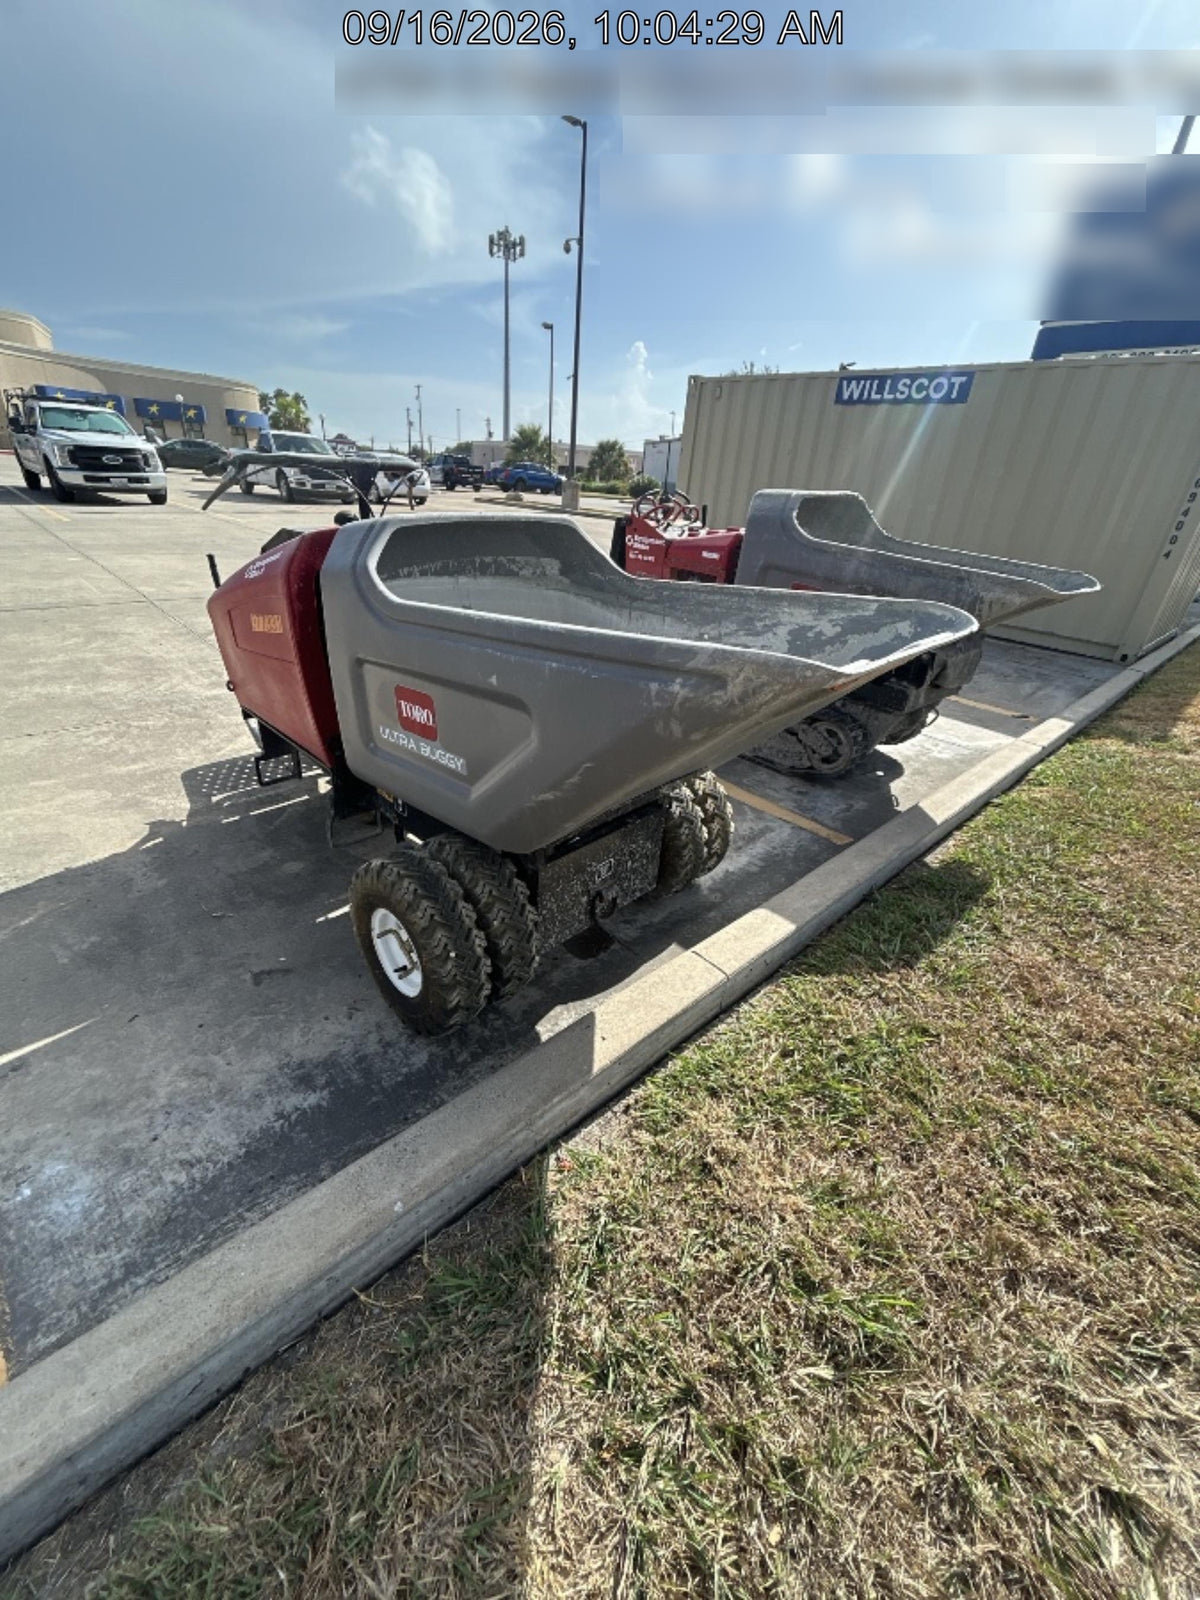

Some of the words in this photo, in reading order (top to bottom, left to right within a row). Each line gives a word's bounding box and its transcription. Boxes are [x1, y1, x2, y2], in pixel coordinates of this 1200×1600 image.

[842, 376, 968, 400] WILLSCOT
[398, 699, 434, 726] TORO
[379, 725, 418, 753] ULTRA
[419, 742, 467, 776] BUGGY
